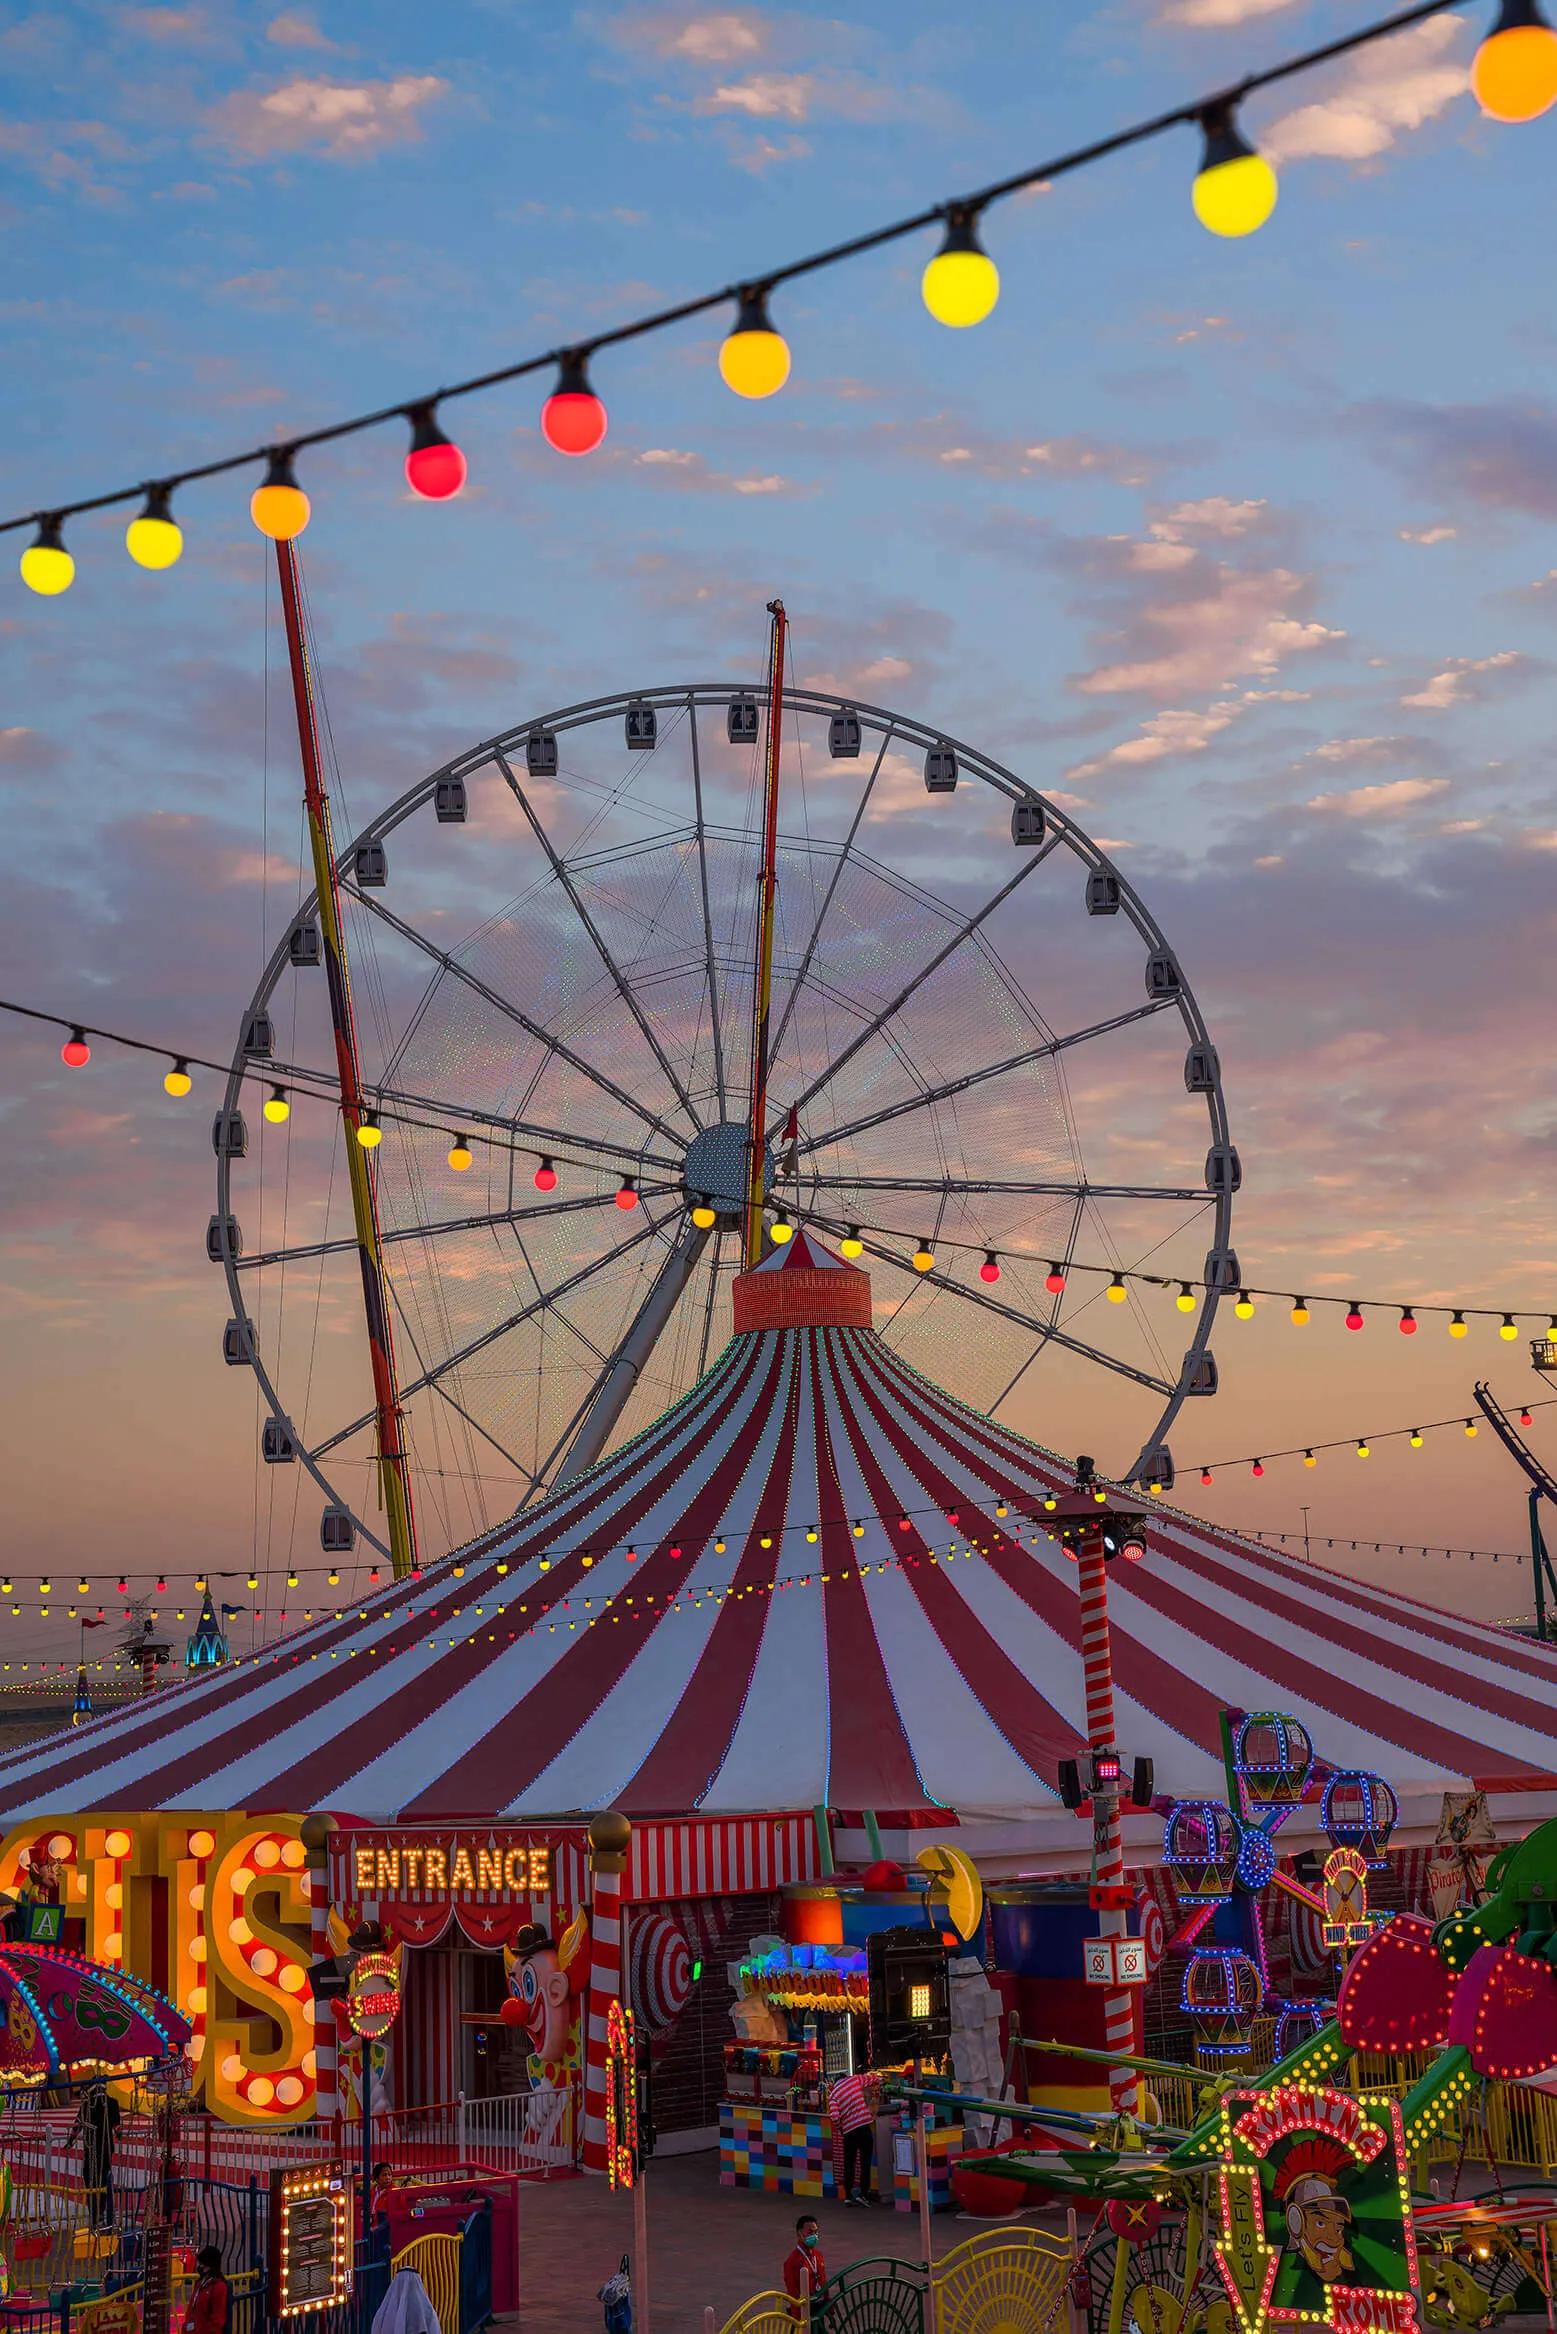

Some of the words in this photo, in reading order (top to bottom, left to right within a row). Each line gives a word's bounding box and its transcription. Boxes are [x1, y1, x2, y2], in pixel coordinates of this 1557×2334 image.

[355, 1847, 550, 1890] ENTRANCE
[34, 1911, 55, 1936] A
[1240, 2089, 1383, 2150] ROAMING
[1233, 2187, 1250, 2222] Fly
[1238, 2232, 1257, 2291] Let's
[1332, 2293, 1415, 2333] ROME
